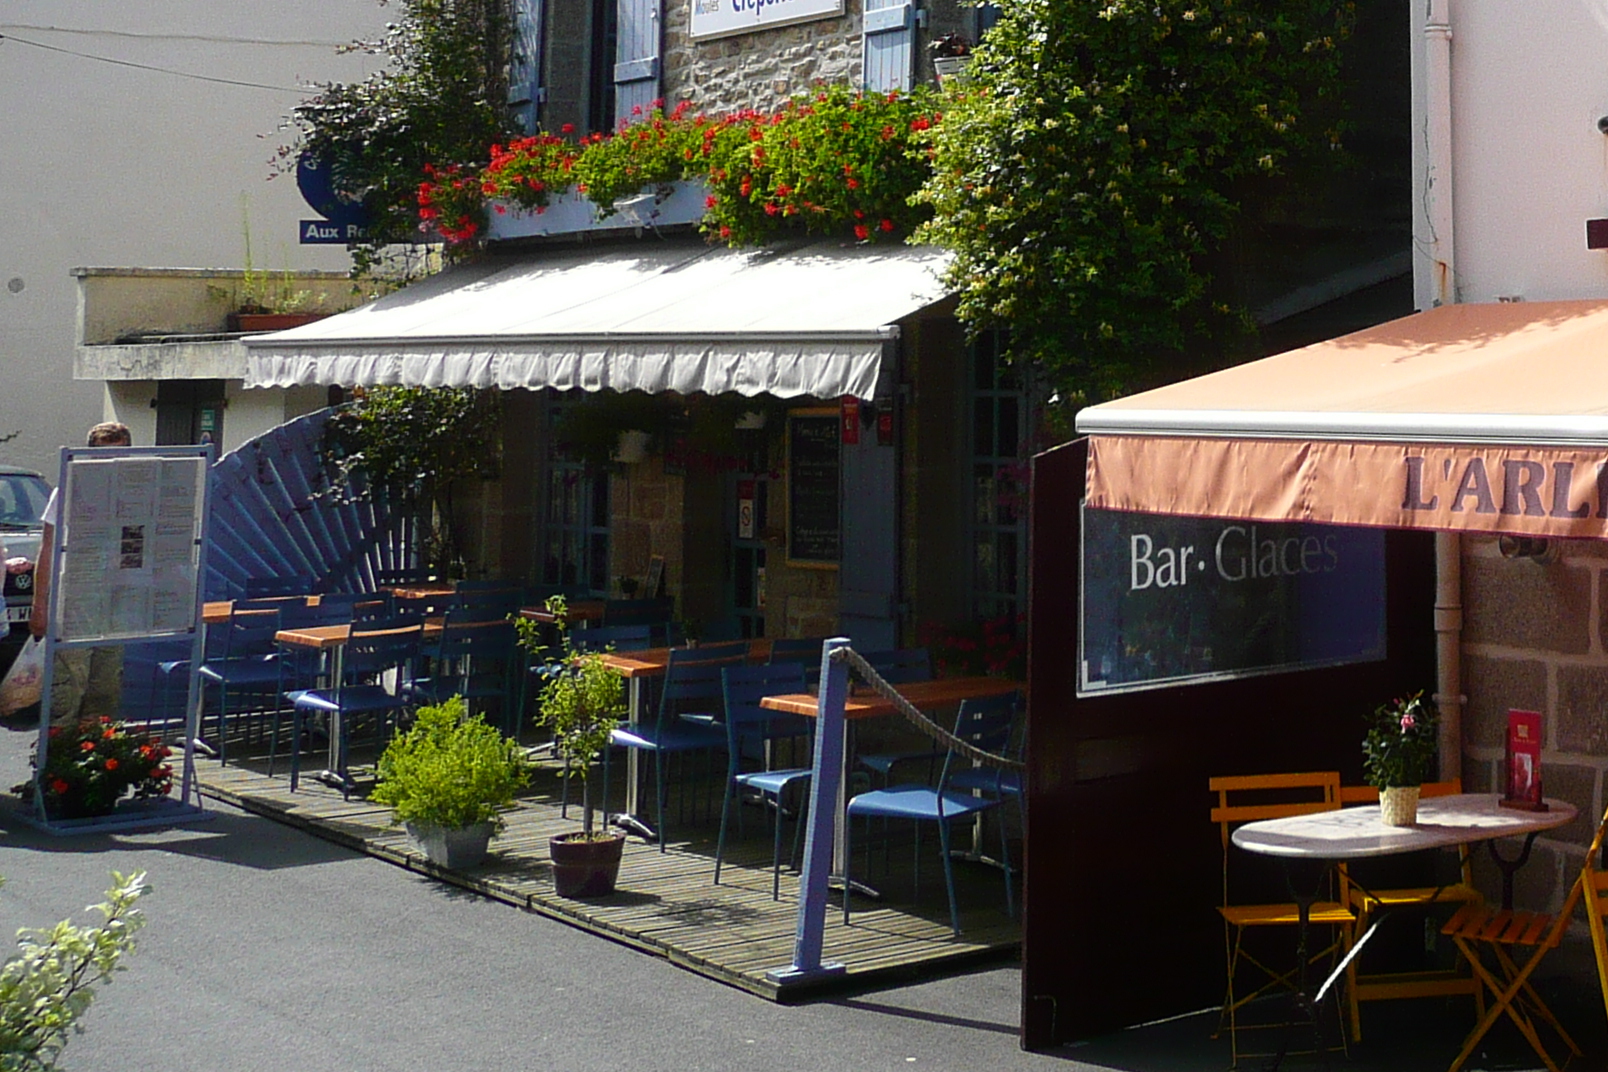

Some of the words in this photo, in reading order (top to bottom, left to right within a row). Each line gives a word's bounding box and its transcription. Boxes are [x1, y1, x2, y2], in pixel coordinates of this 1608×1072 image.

[306, 224, 340, 239] Aux
[1130, 533, 1194, 592] Bar
[1215, 525, 1339, 583] Glaces
